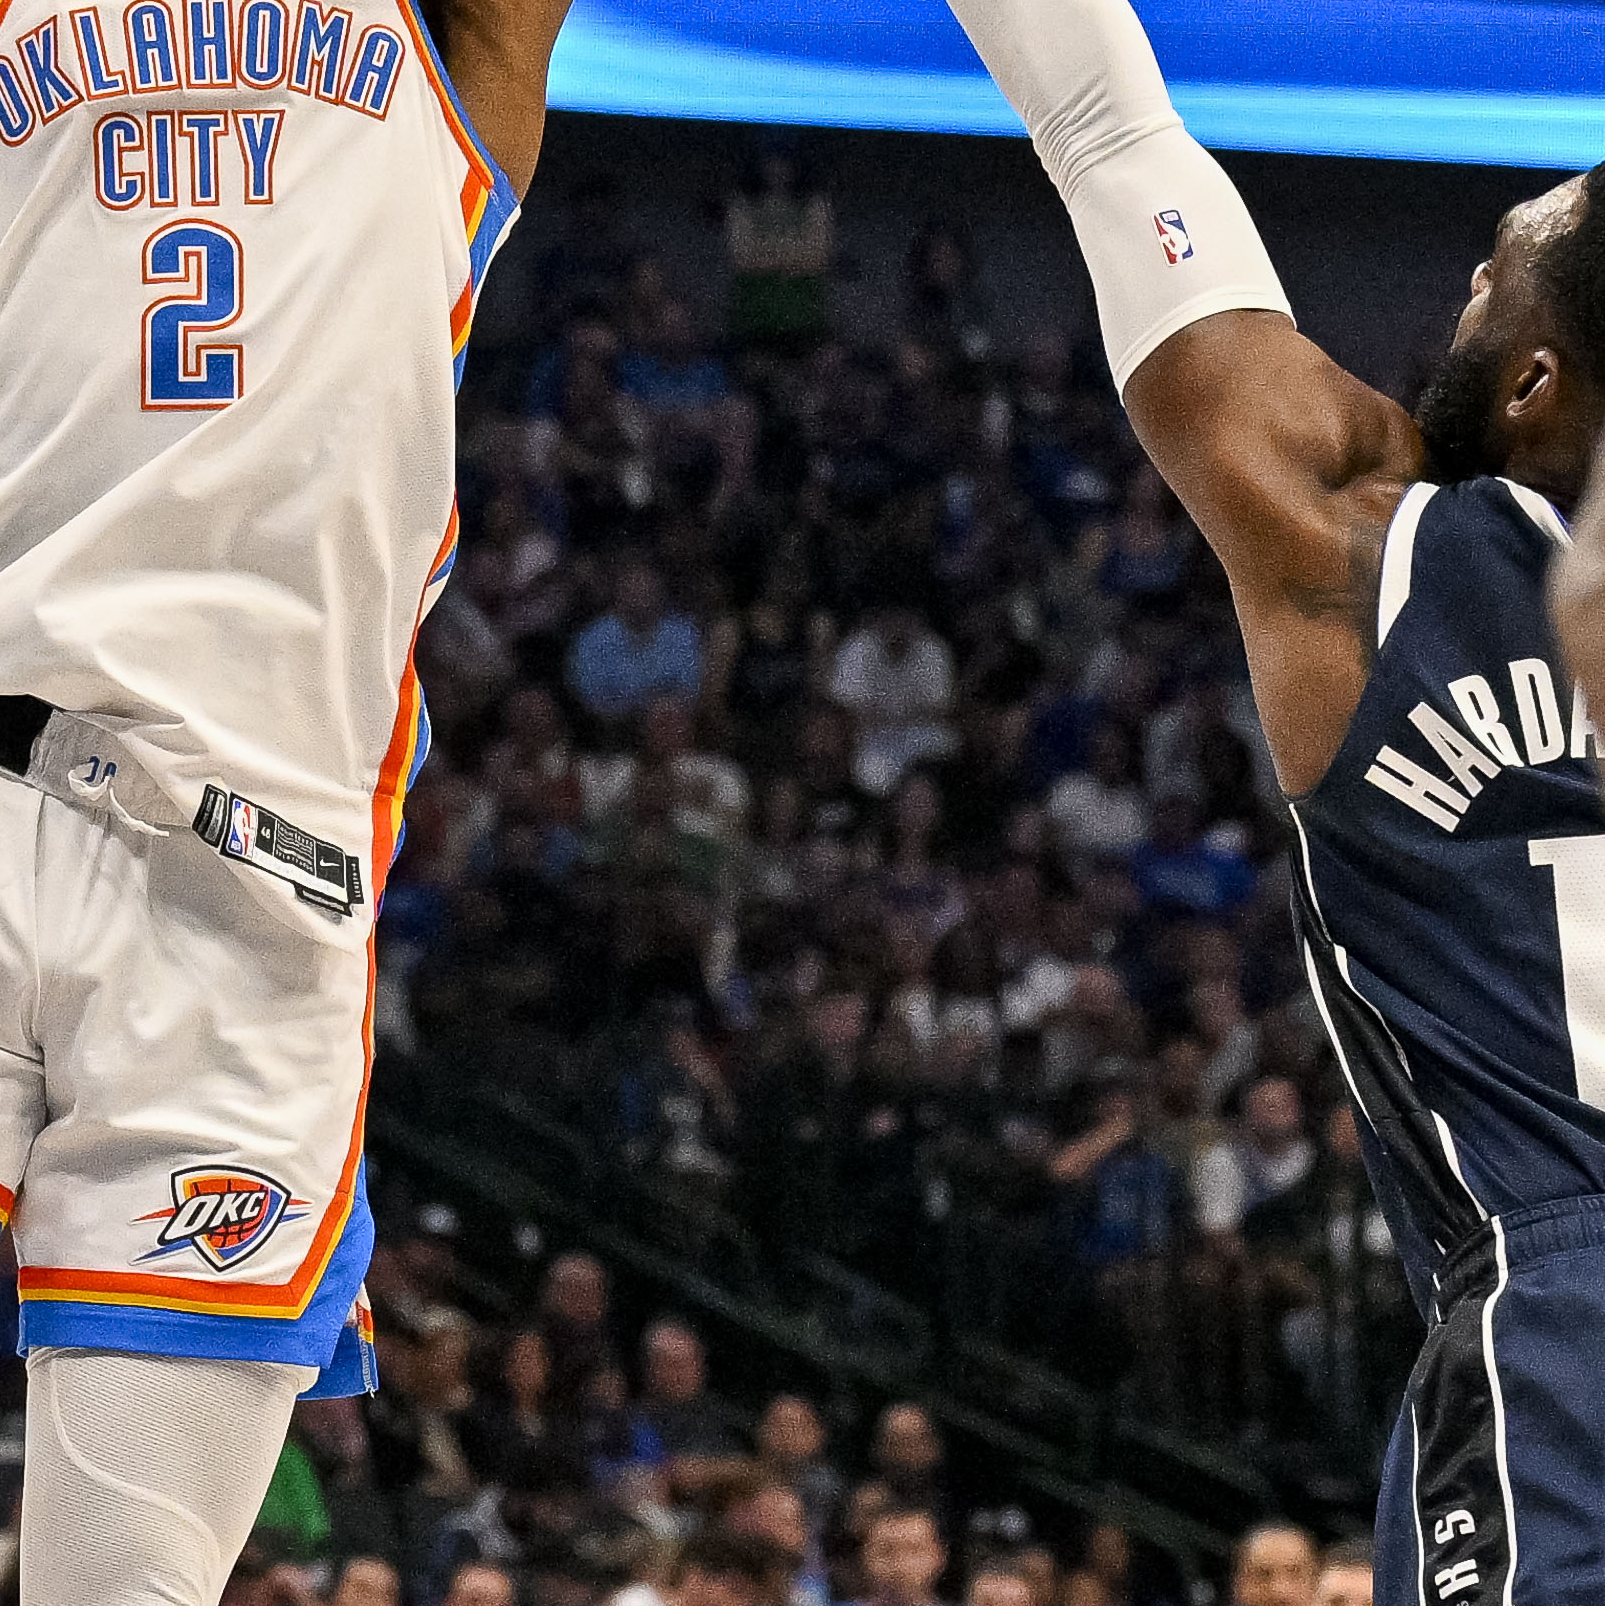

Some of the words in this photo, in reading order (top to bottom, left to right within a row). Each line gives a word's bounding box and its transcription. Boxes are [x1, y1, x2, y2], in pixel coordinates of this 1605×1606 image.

[94, 110, 285, 210] CITY
[142, 219, 244, 410] 2
[165, 1192, 266, 1240] OKC
